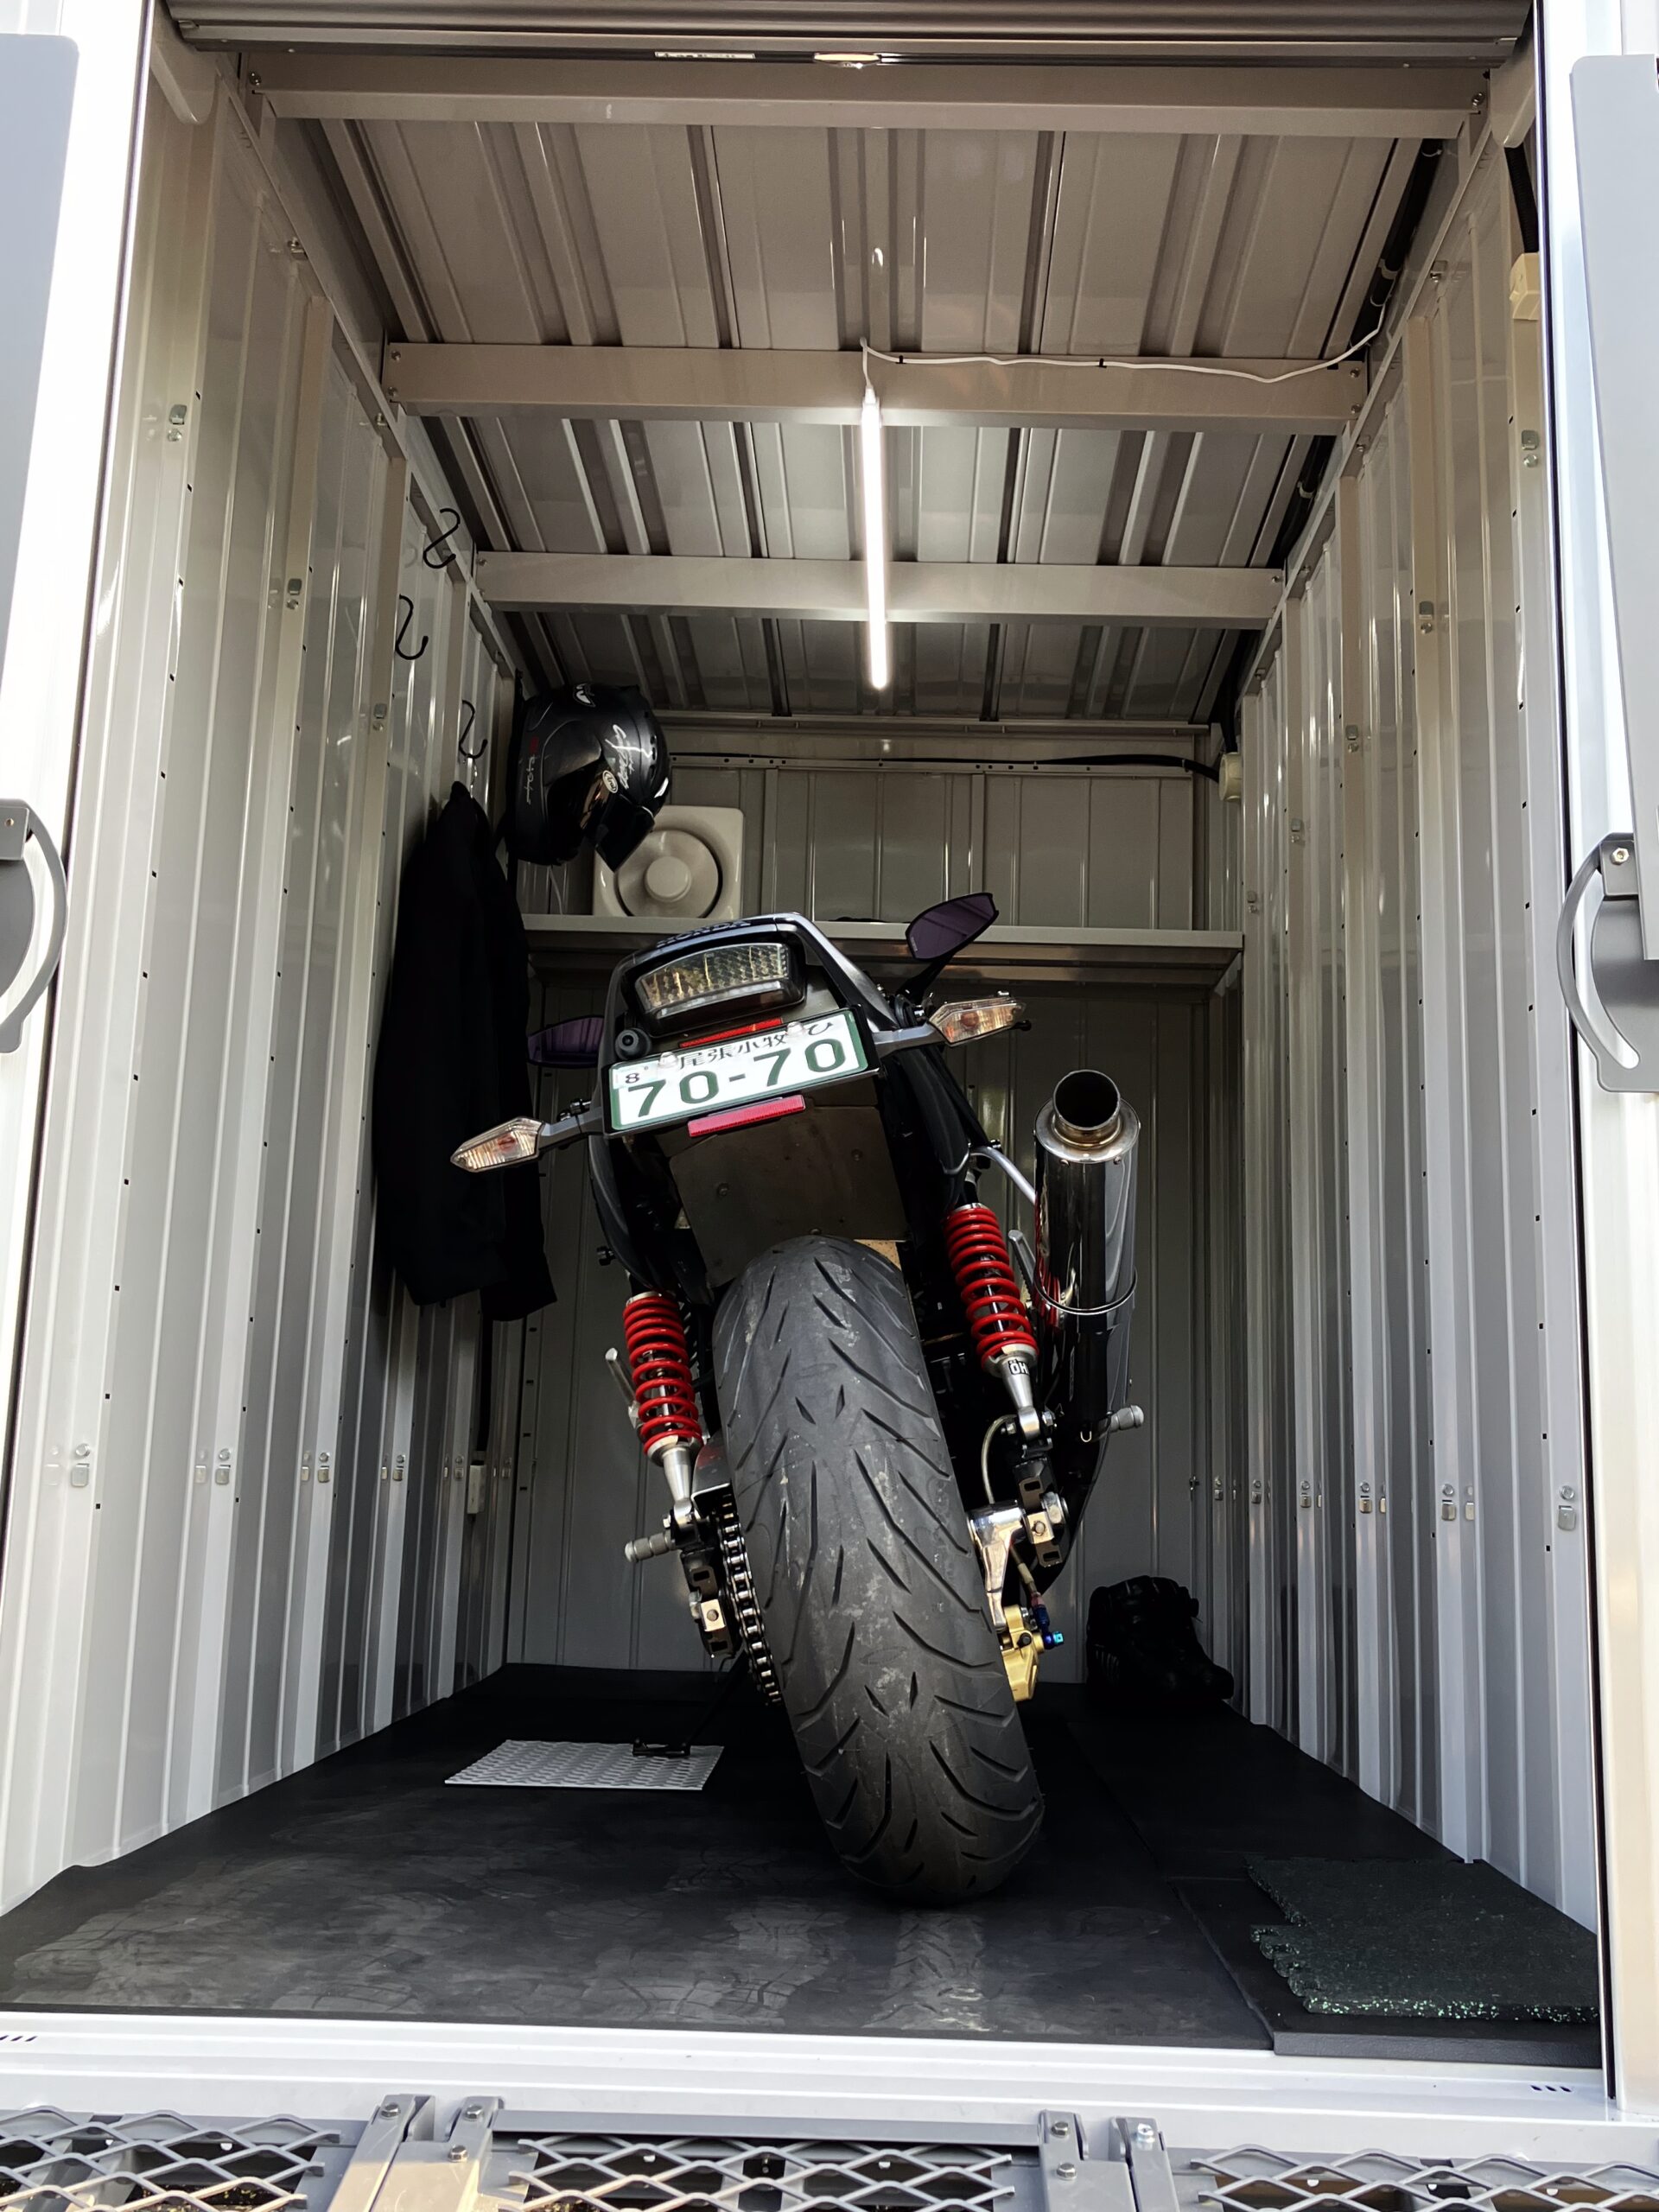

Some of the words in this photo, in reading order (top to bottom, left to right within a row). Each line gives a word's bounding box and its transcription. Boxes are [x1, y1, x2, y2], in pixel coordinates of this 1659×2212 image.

[627, 1039, 846, 1117] 70-70
[679, 1032, 787, 1069] 尾張小牧
